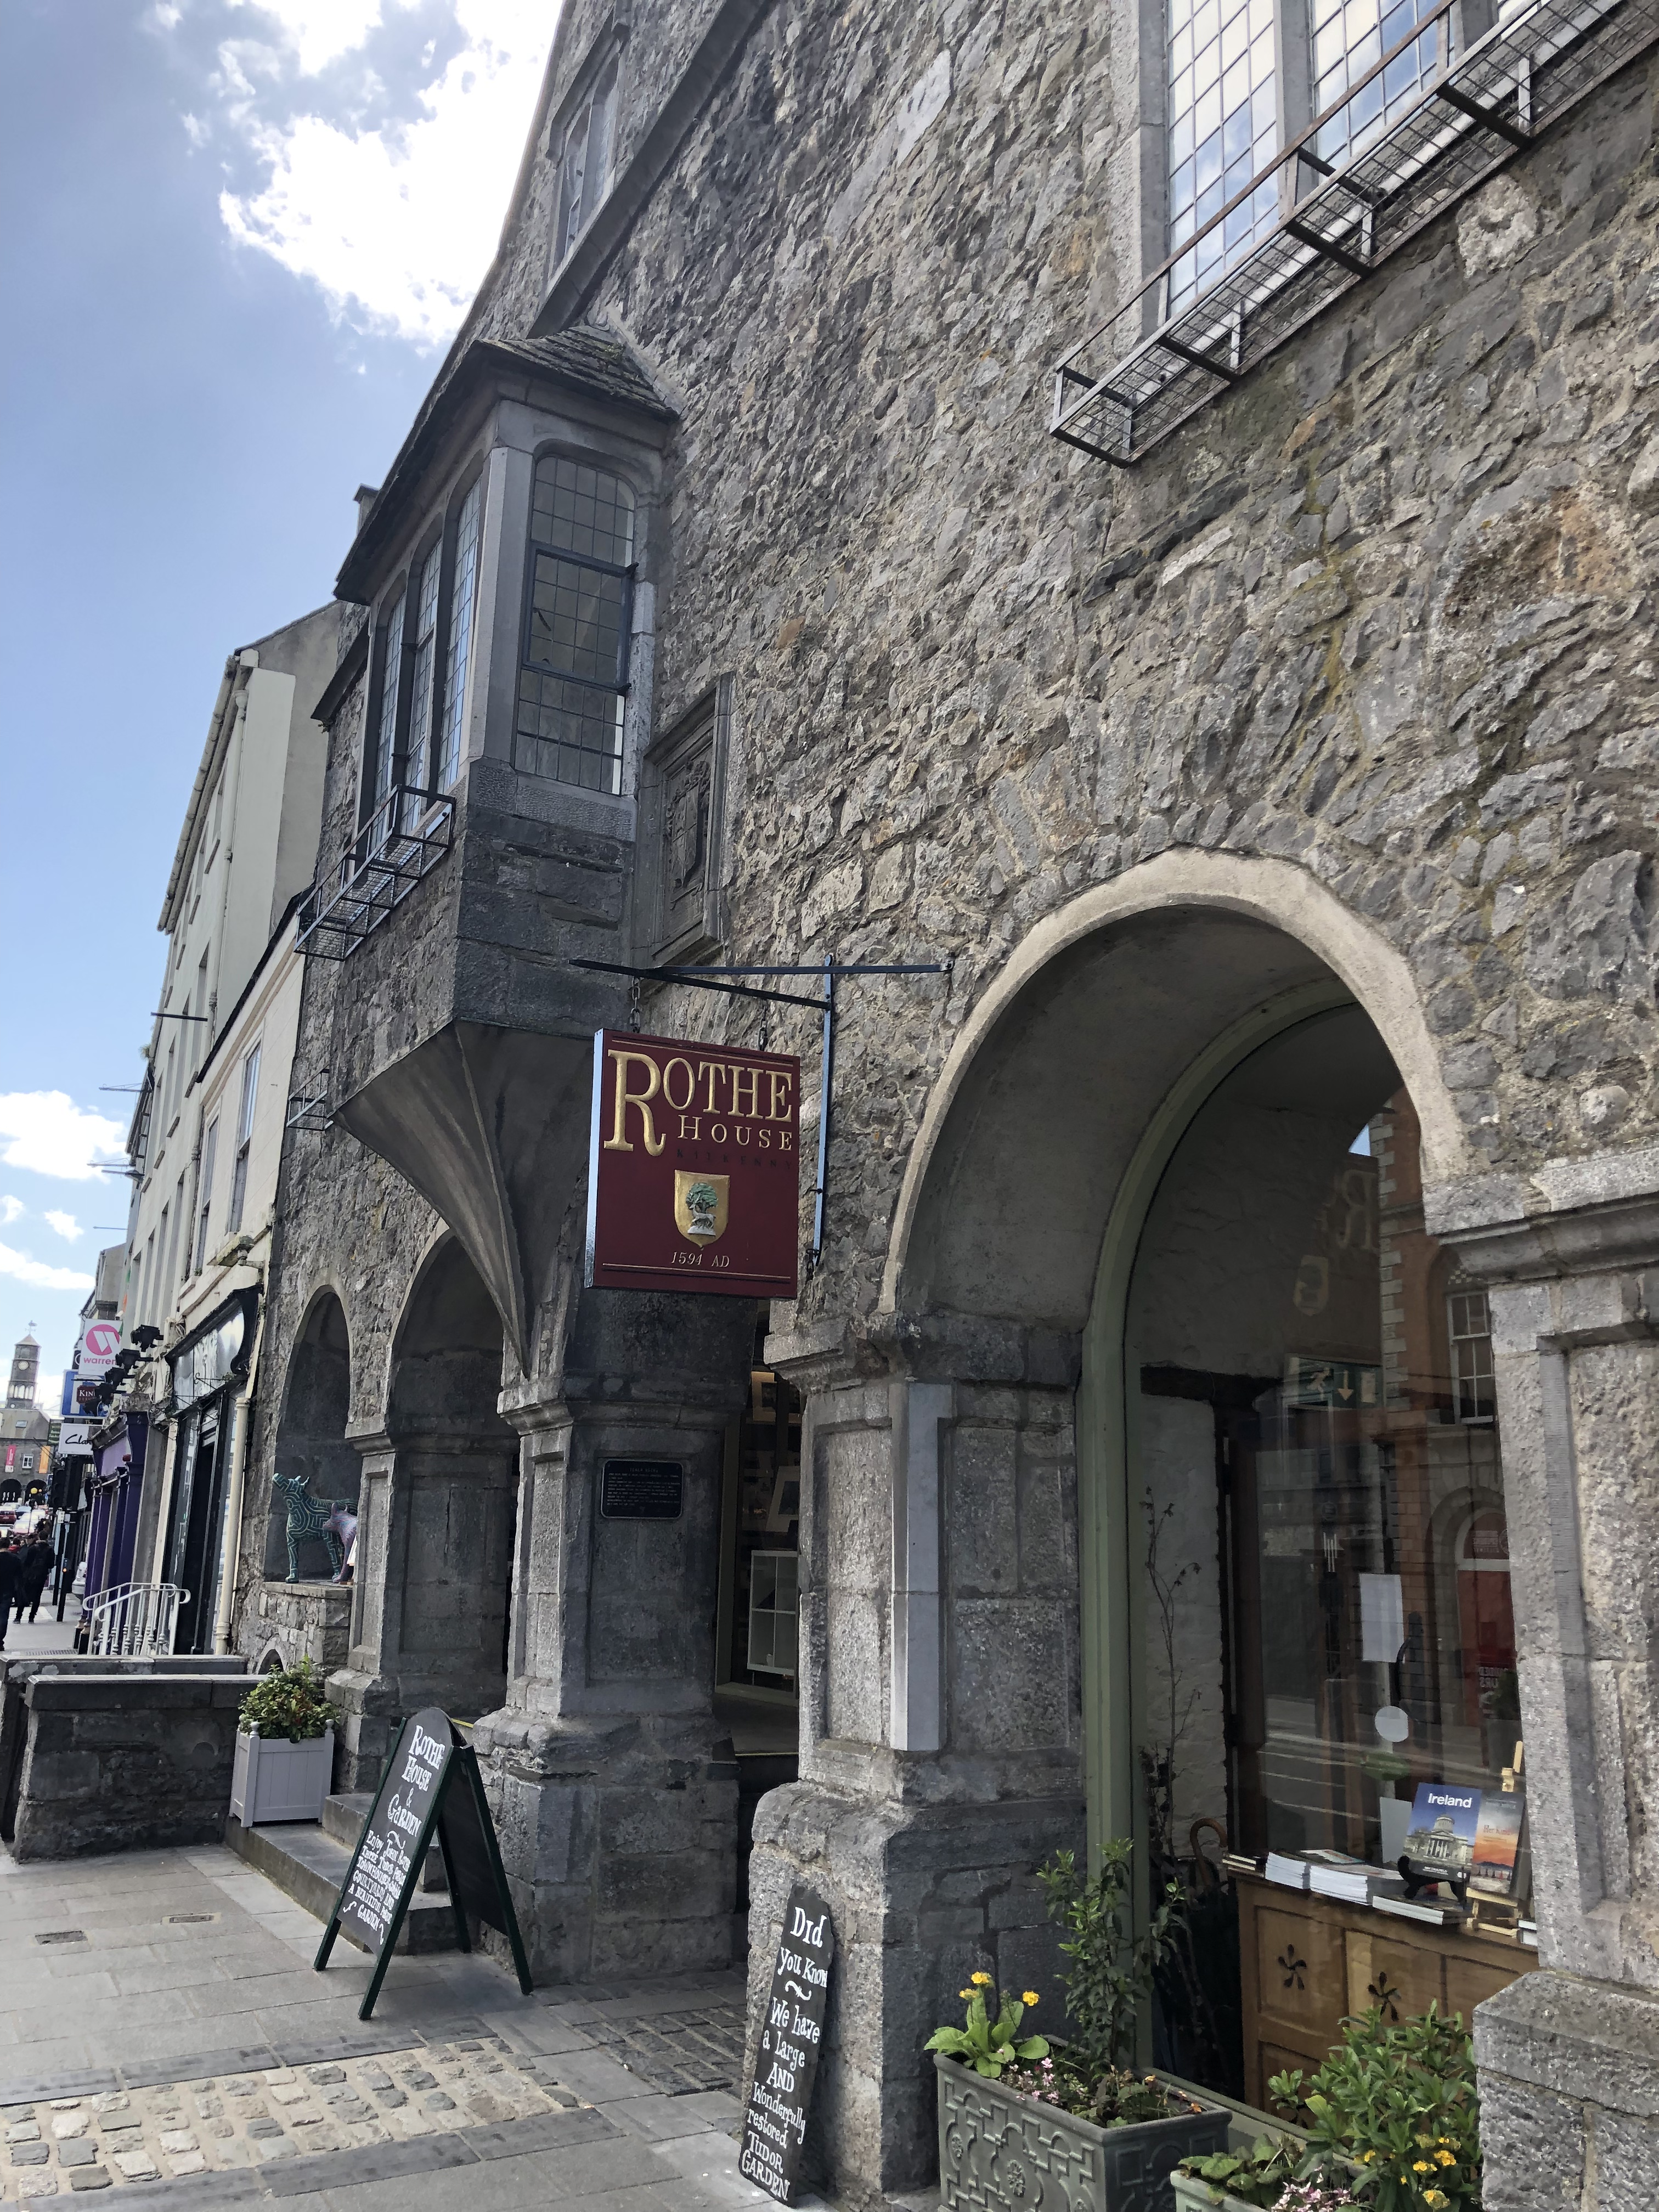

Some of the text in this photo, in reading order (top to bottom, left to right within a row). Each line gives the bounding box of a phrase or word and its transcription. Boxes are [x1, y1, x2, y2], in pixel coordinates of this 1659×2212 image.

[603, 1049, 792, 1156] ROTHE
[677, 1114, 792, 1151] HOUSE
[671, 1251, 730, 1267] 1594 AD
[408, 1725, 445, 1770] ROTHE
[401, 1755, 432, 1792] HOUSE
[406, 1787, 414, 1808] &
[1427, 1792, 1473, 1808] Ireland
[366, 1830, 384, 1854] Enjoy
[348, 1883, 381, 1914] A BEAUTIFUL
[357, 1904, 381, 1931] GARDEN
[802, 1957, 828, 1988] Know
[770, 1996, 820, 2044] We have
[763, 2029, 771, 2050] a
[766, 2062, 794, 2092] AND
[747, 2108, 789, 2149] restored
[753, 2081, 806, 2145] Wonderfully
